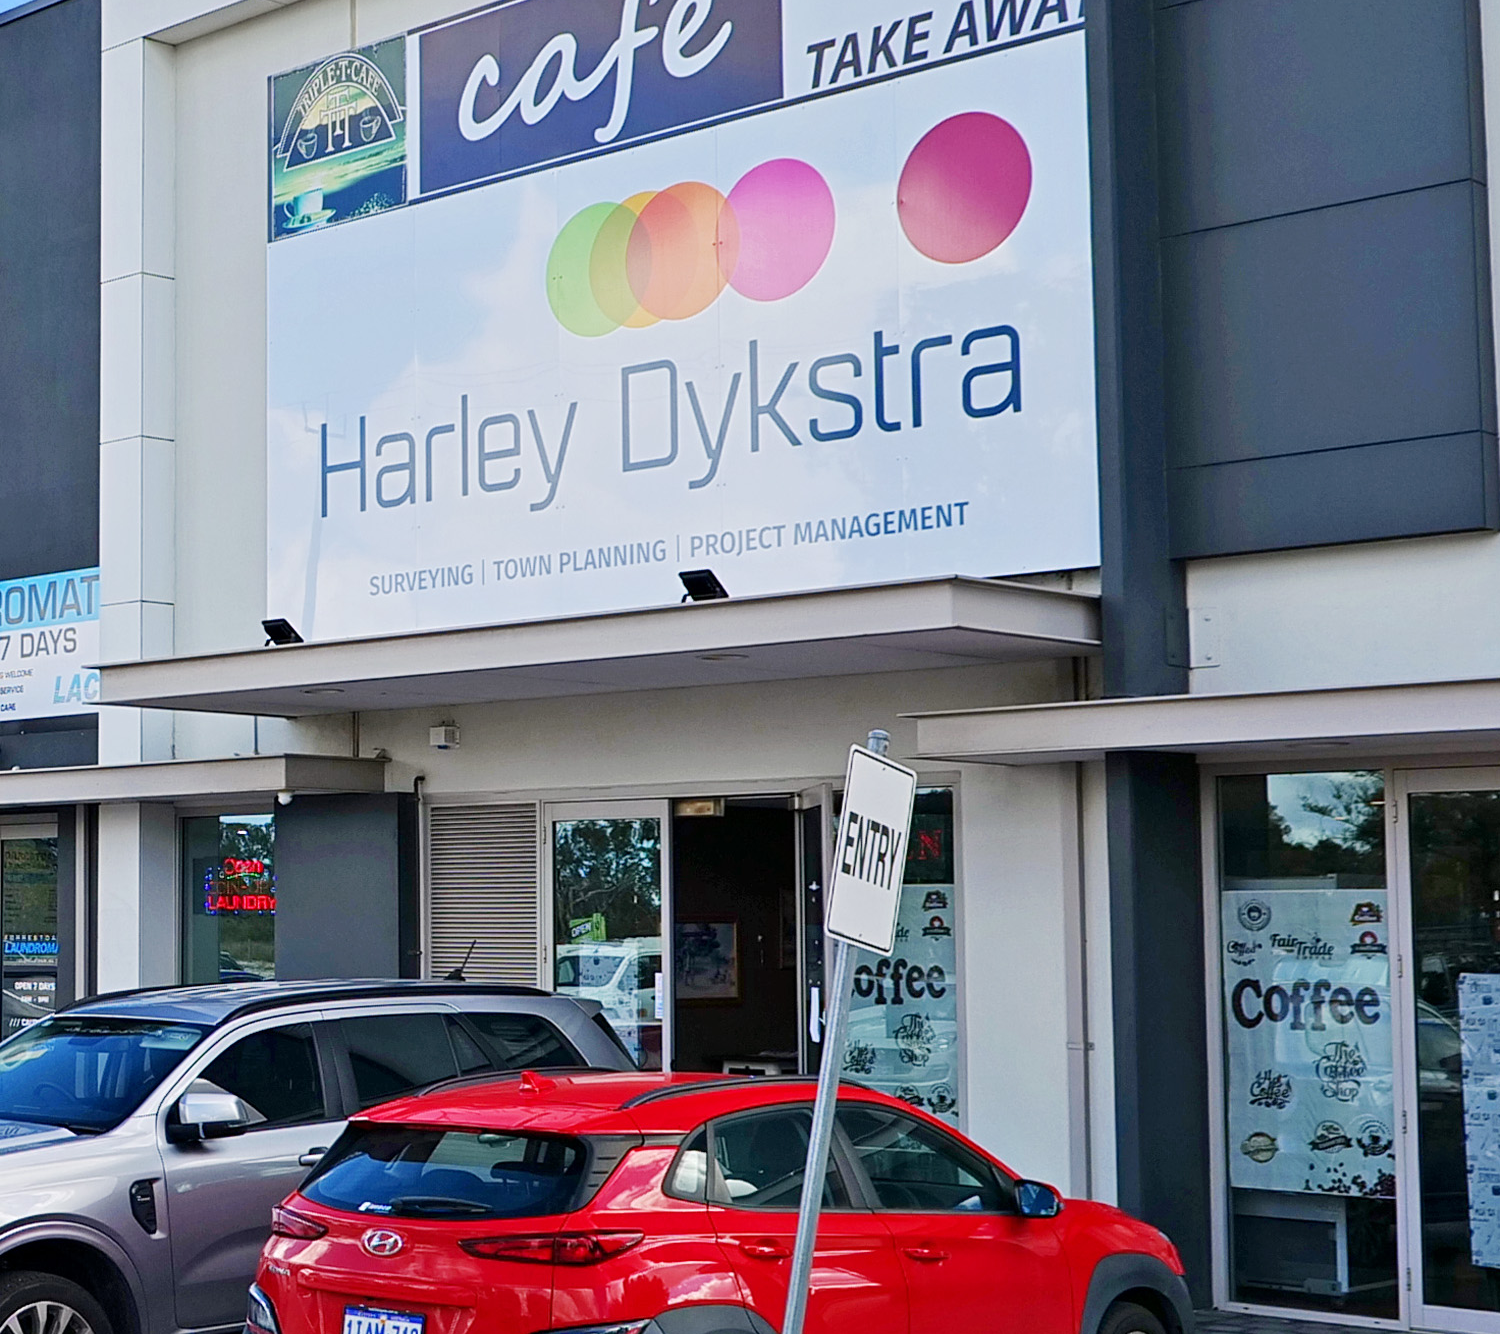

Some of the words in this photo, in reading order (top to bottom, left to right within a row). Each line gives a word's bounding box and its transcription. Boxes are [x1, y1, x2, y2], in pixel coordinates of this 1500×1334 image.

[805, 9, 935, 89] TAKE
[318, 391, 577, 519] Harley
[620, 323, 1023, 490] Dykstra
[368, 562, 475, 598] SURVEYING
[492, 550, 552, 583] TOWN
[558, 538, 668, 577] PLANNING
[688, 523, 786, 560] PROJECT
[793, 499, 971, 546] MANAGEMENT
[0, 635, 11, 661] 7
[20, 627, 78, 659] DAYS
[841, 811, 902, 891] ENTRY
[208, 895, 278, 910] LAUNDRY
[1270, 934, 1297, 948] Fair
[1294, 942, 1335, 956] Trade
[852, 958, 947, 1005] offee
[1232, 978, 1381, 1031] Coffee
